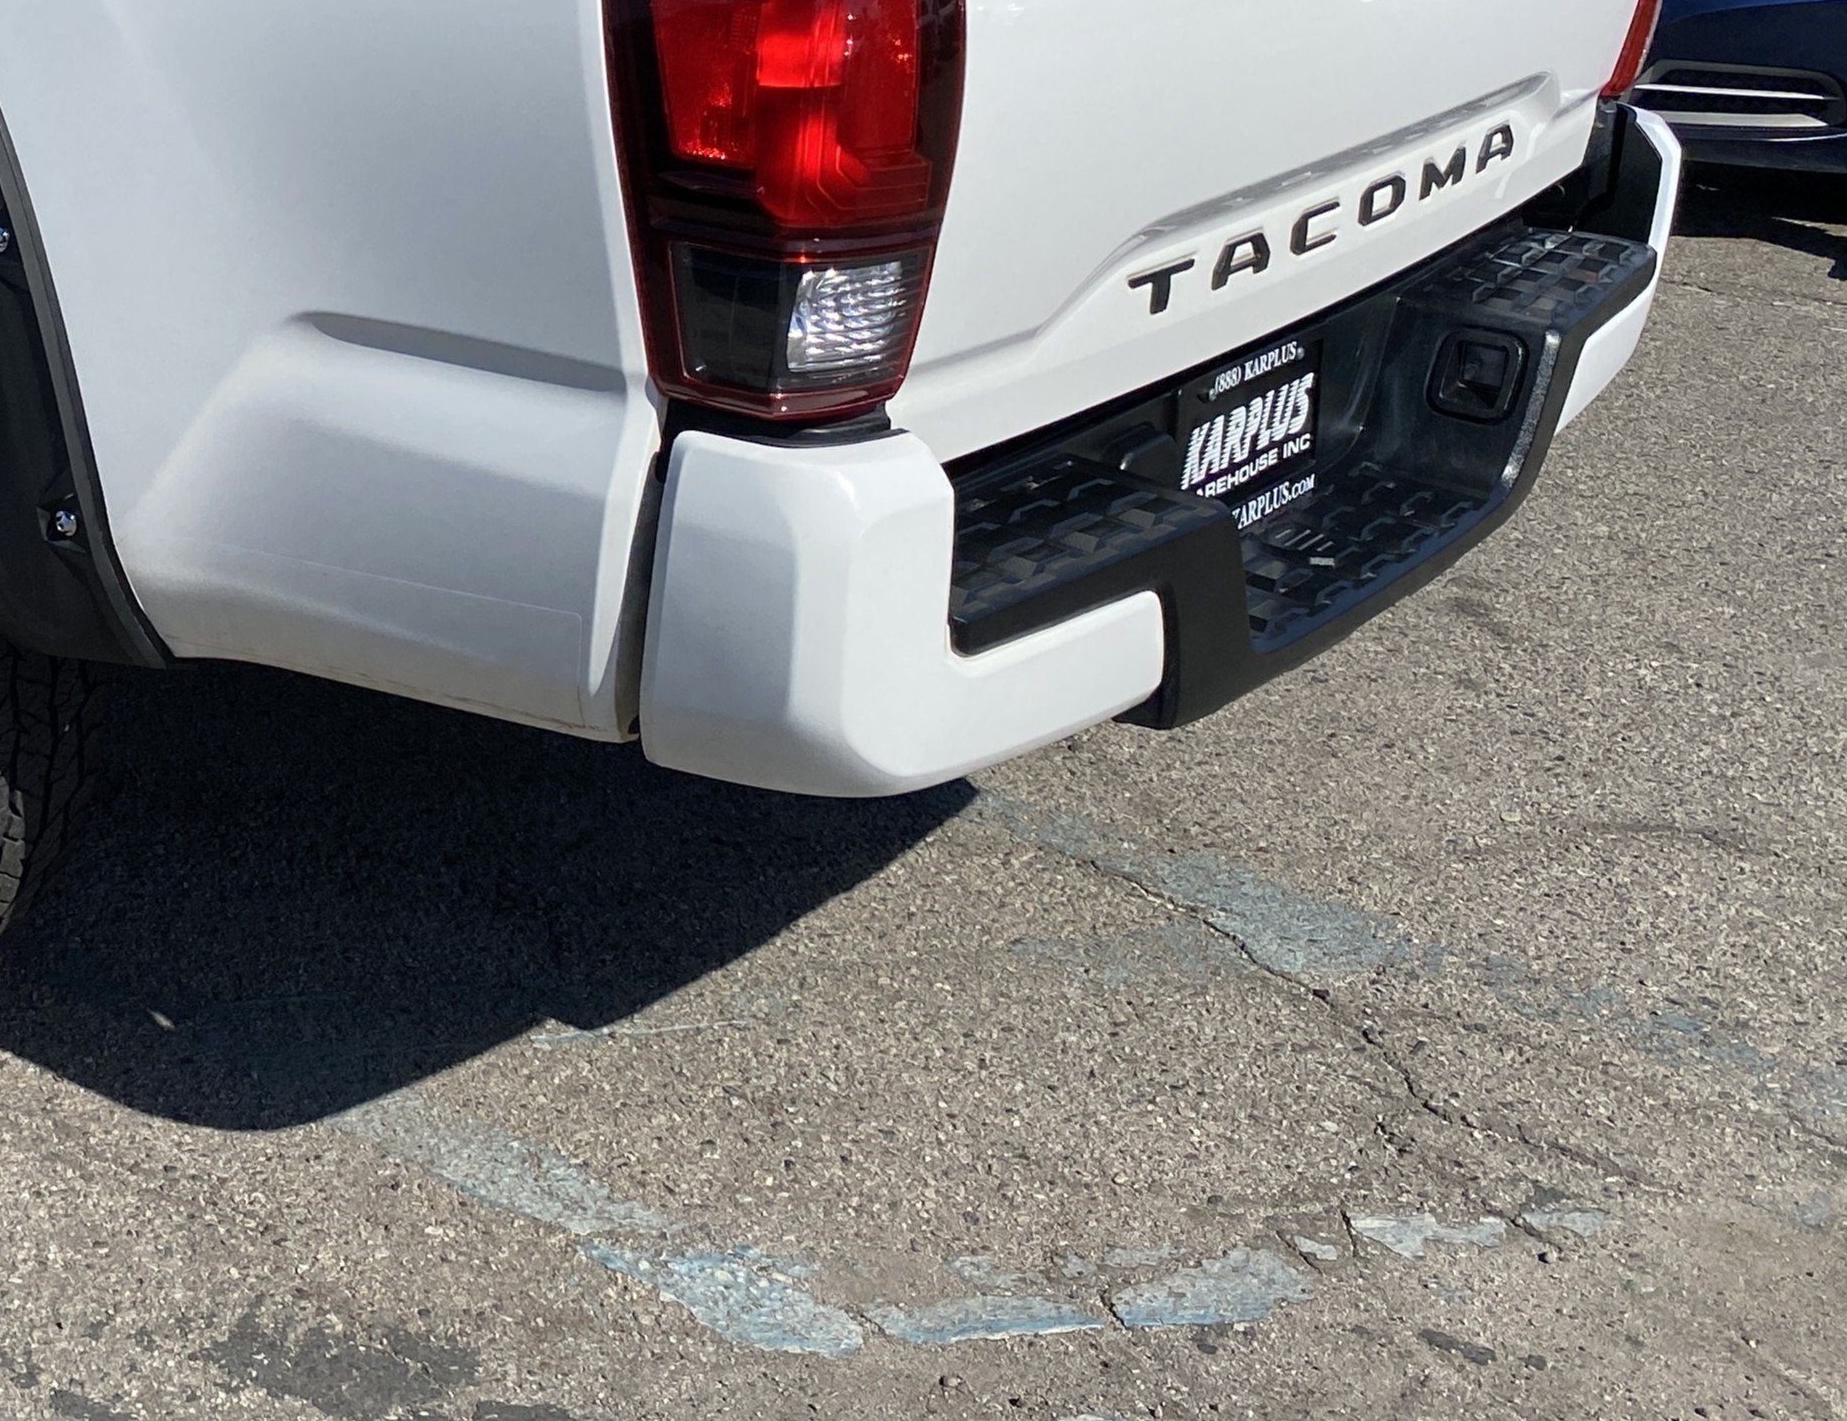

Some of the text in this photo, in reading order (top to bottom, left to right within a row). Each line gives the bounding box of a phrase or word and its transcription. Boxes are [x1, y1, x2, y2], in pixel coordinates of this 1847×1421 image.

[1126, 121, 1515, 315] TACOMA
[1213, 341, 1298, 396] (888) KARPLUS
[1180, 371, 1315, 490] KARPLUS
[1196, 433, 1312, 498] REHOUSE INC
